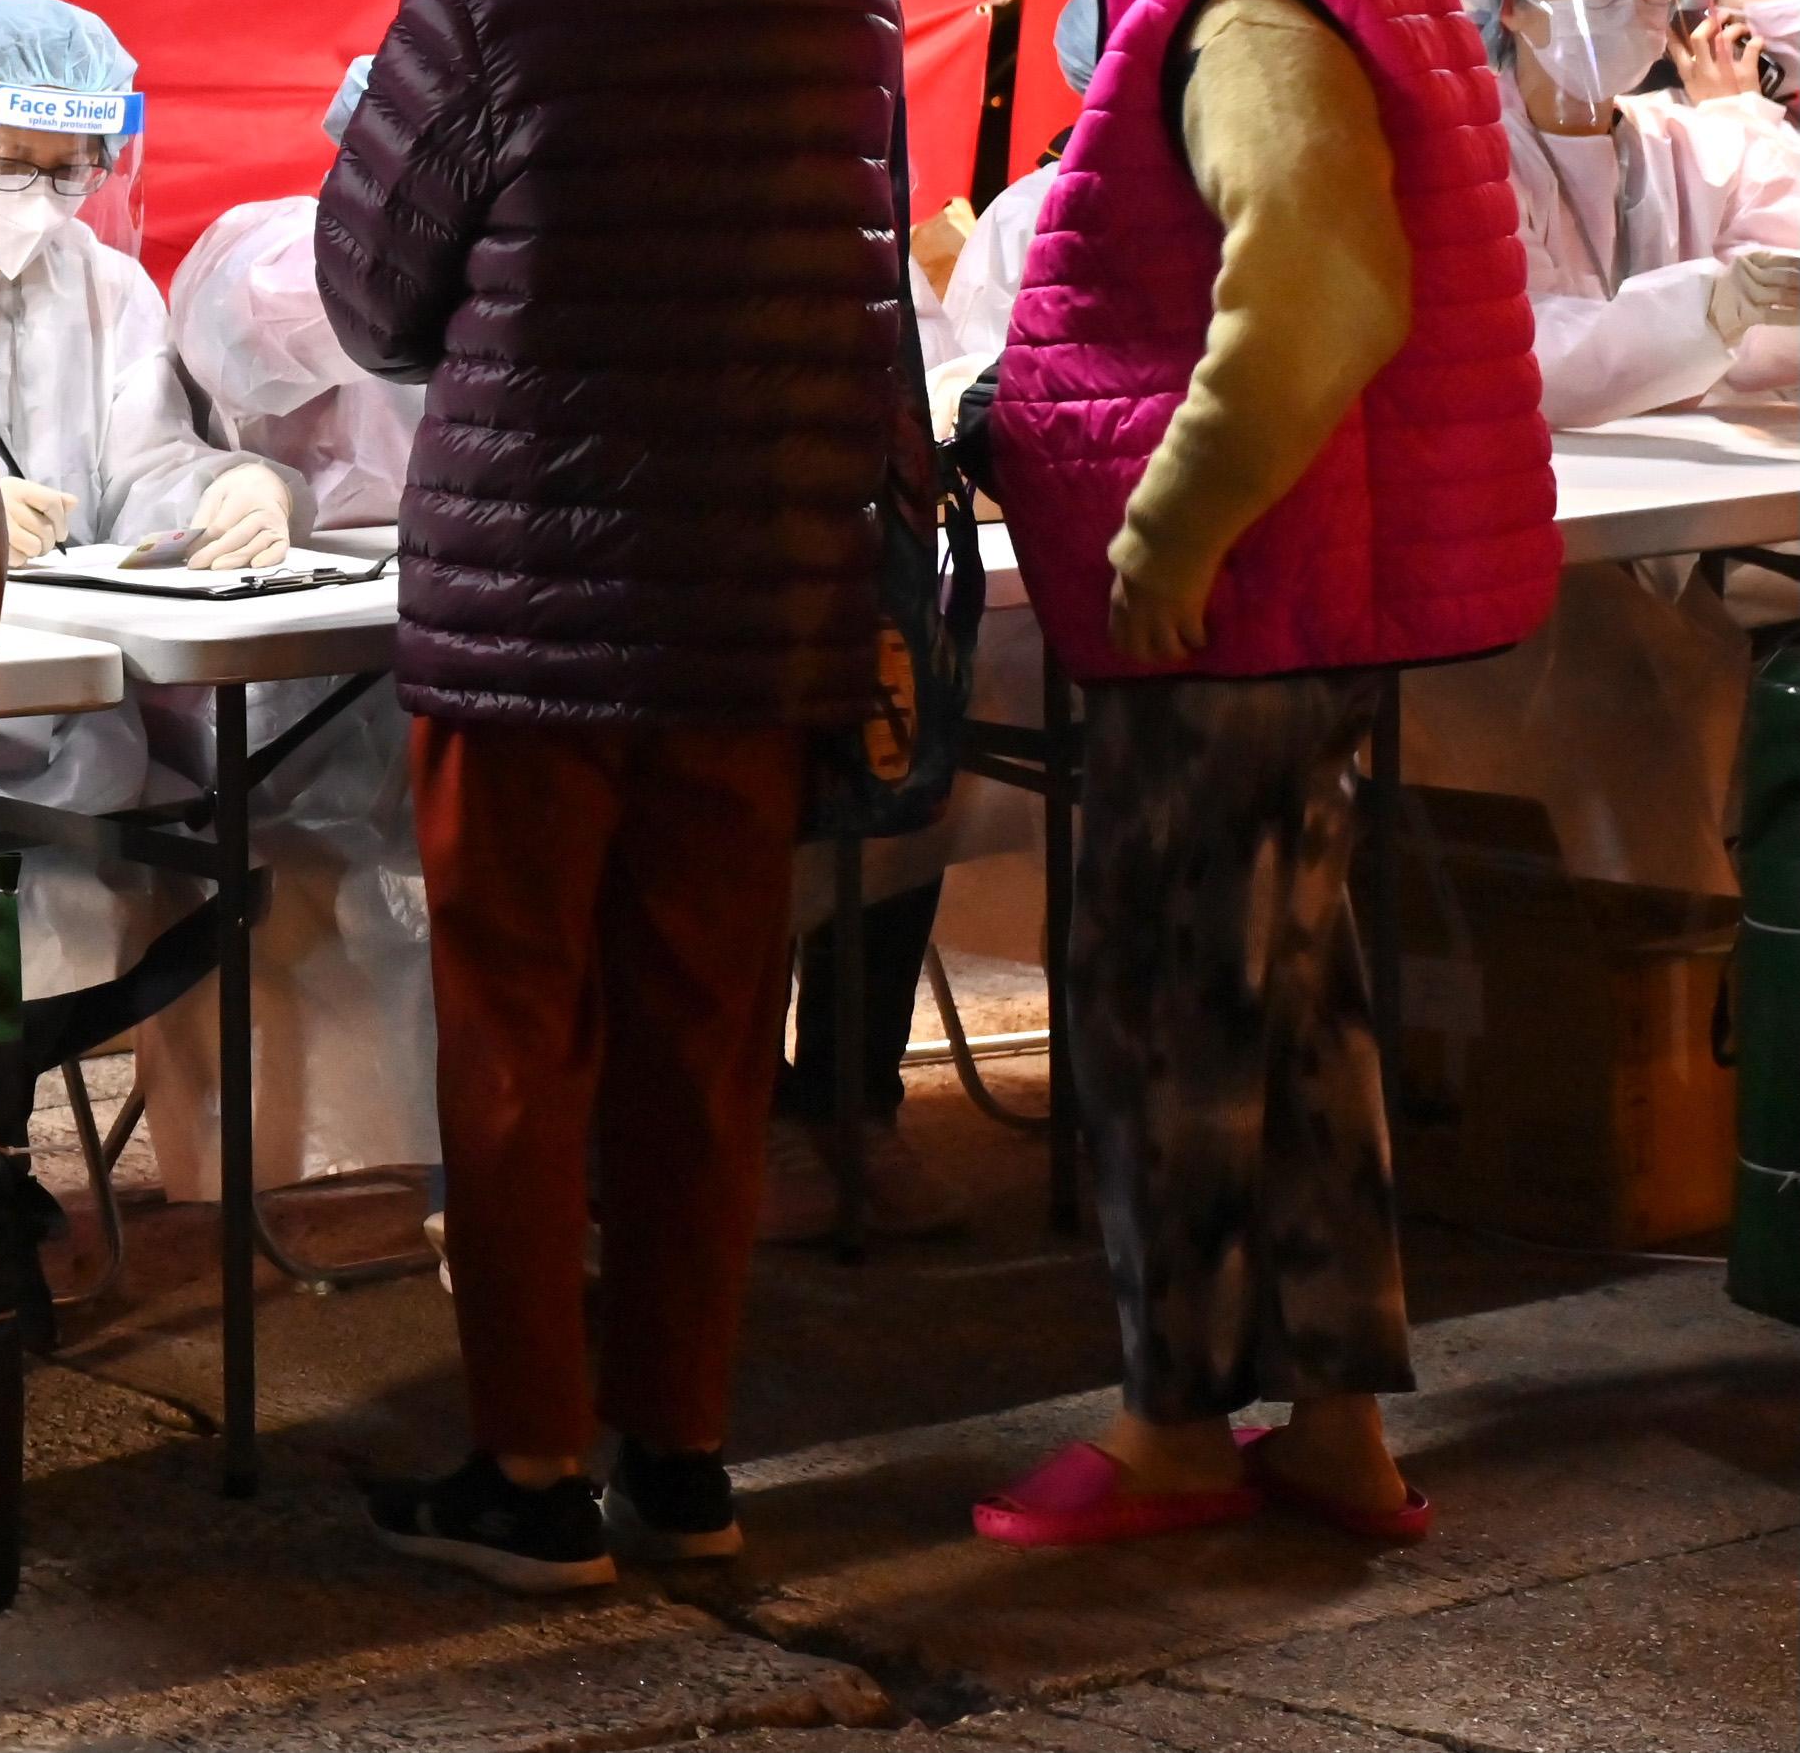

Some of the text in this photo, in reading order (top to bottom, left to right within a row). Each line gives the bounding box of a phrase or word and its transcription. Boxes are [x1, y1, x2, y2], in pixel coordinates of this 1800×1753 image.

[9, 93, 117, 120] Face Shield
[29, 117, 103, 130] splash protection
